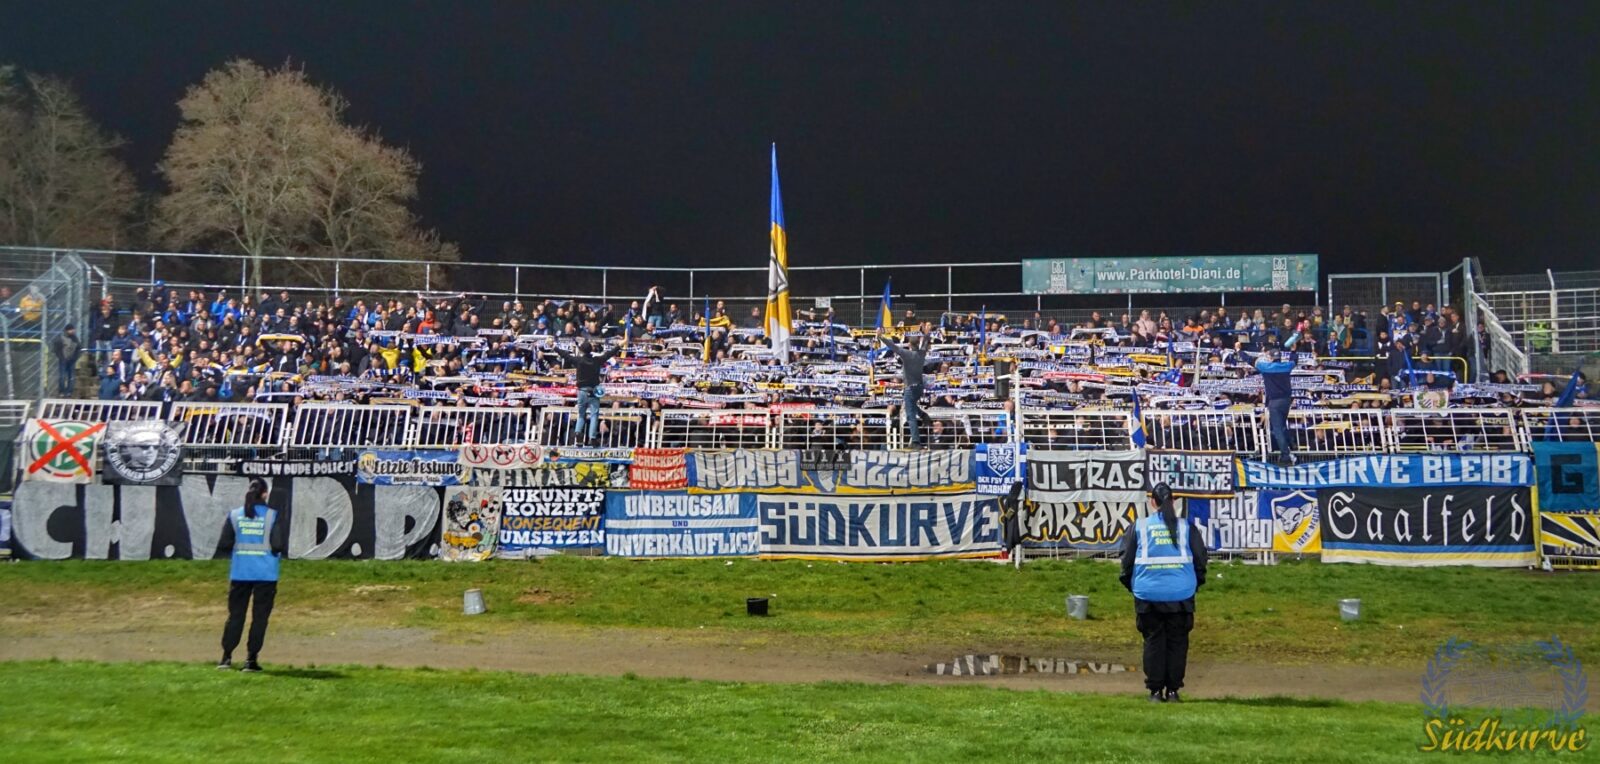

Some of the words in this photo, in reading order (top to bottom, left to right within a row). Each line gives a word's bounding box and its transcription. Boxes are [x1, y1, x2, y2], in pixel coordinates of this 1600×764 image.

[1097, 268, 1241, 281] www.Parkhotel-Diani.de
[242, 462, 269, 475] CHUJ
[272, 462, 281, 475] W
[373, 458, 409, 475] Letzte
[412, 458, 463, 476] Festung
[1149, 454, 1231, 472] REFUGEES
[1422, 455, 1531, 484] BLEIBT
[474, 467, 578, 487] WEIMAR
[1004, 477, 1024, 485] BLET
[1031, 459, 1146, 491] ULTRAS
[1149, 472, 1231, 491] WELCOME
[1550, 454, 1584, 493] G
[502, 488, 605, 502] ZUKUNFTS
[505, 502, 600, 516] KONZEPT
[625, 494, 740, 516] UNBEUGSAM
[502, 515, 601, 531] KONSEQUENT
[761, 501, 998, 546] SÜDKURVE
[1327, 491, 1527, 546] Saalfeld
[500, 530, 605, 544] UMSETZEN
[606, 530, 760, 556] UNVERKÄUFLICH
